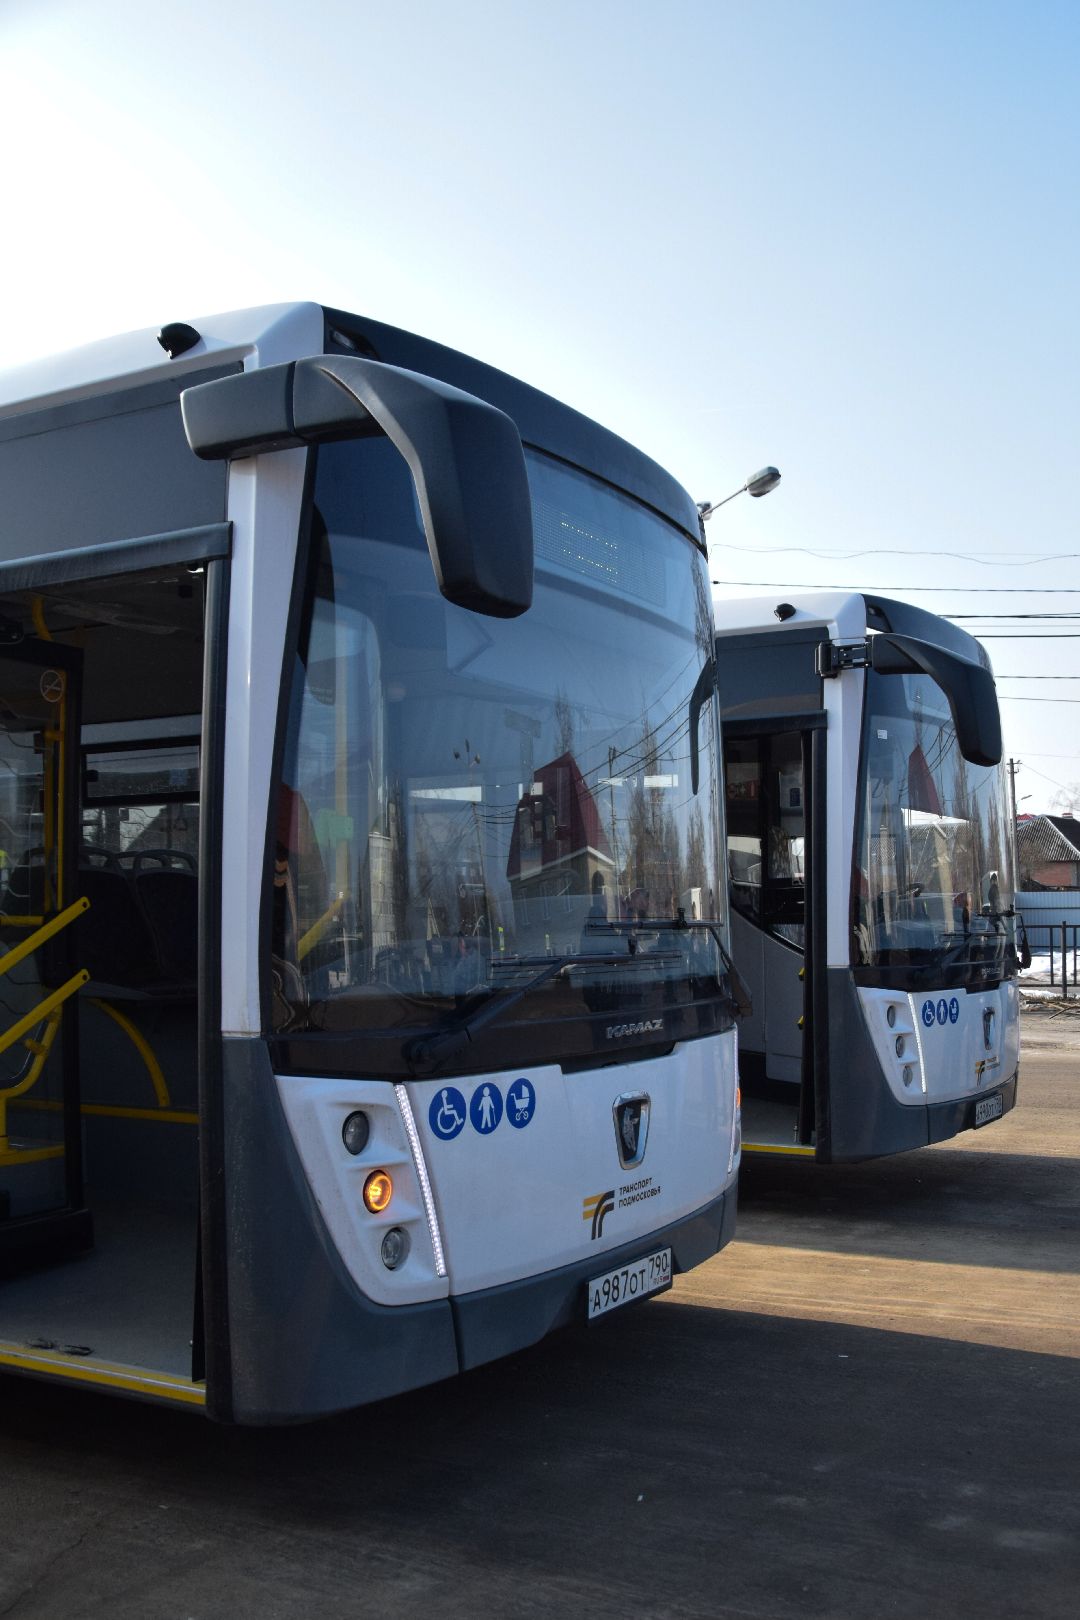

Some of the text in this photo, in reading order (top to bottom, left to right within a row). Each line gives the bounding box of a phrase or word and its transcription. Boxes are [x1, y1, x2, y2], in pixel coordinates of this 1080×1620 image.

[606, 1019, 664, 1039] KAMAZ
[618, 1185, 661, 1208] ПОДМОСКОВЬЯ
[619, 1177, 653, 1196] ТРАНСПОРТ
[592, 1252, 668, 1312] А987ОТ 790
